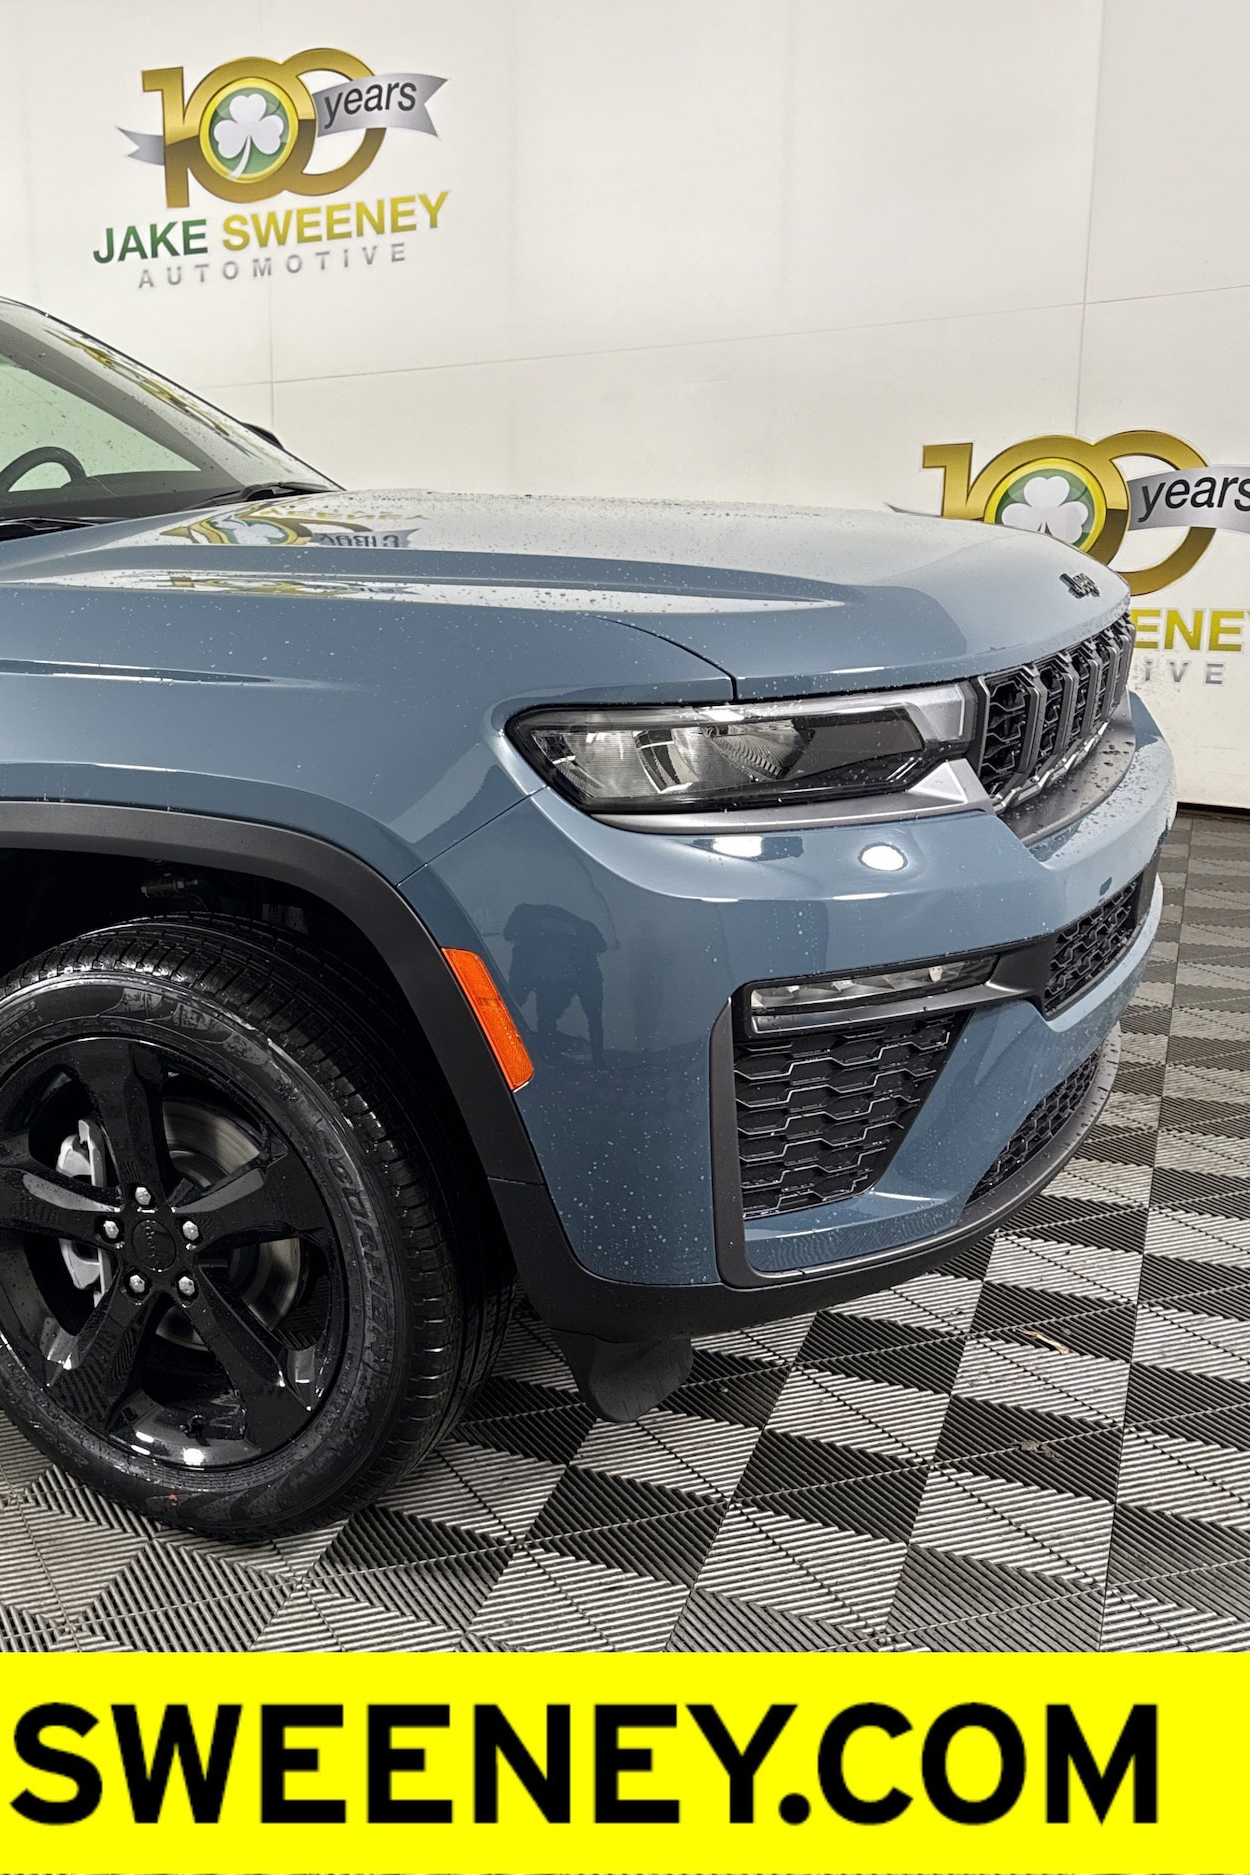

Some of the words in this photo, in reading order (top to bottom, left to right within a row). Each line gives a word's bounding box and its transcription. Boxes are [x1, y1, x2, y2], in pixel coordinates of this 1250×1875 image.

[324, 81, 417, 129] years
[93, 219, 208, 263] JAKE
[222, 191, 449, 252] SWEENEY
[138, 243, 406, 288] AUTOMOTIVE
